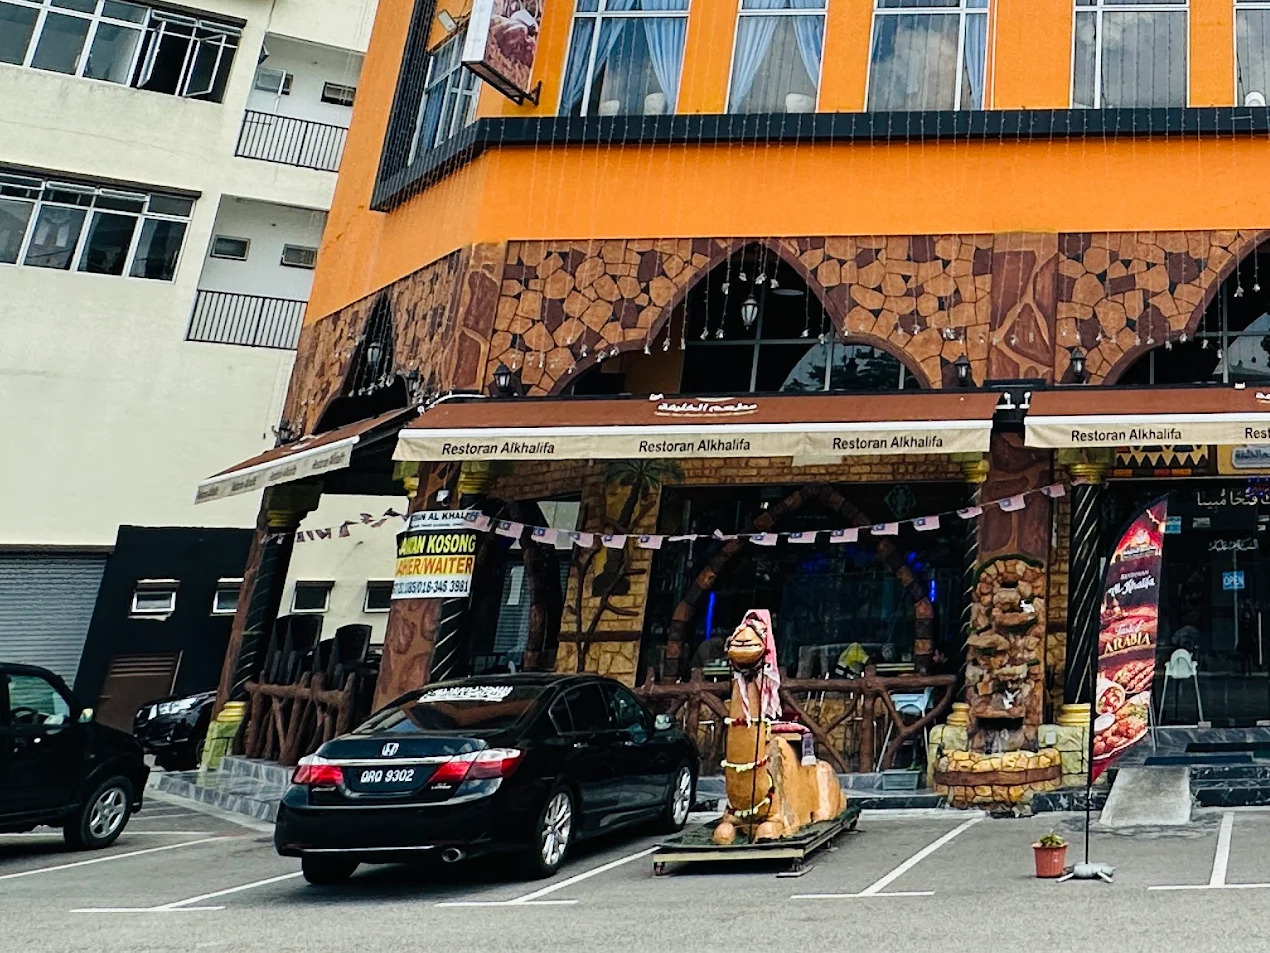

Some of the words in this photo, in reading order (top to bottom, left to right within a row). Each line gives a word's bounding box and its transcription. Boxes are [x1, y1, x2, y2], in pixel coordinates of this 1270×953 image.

[1071, 430, 1126, 442] Restoran
[1129, 428, 1182, 440] Alkhalifa
[442, 442, 497, 455] Restoran
[500, 441, 555, 454] Alkhalifa
[639, 440, 694, 452] Restoran
[697, 438, 751, 451] Alkhalifa
[833, 437, 887, 450] Restoran
[890, 436, 943, 449] Alkhalifa
[426, 534, 477, 554] KOSONG
[1103, 632, 1151, 655] ARABIA
[385, 768, 415, 782] 9302
